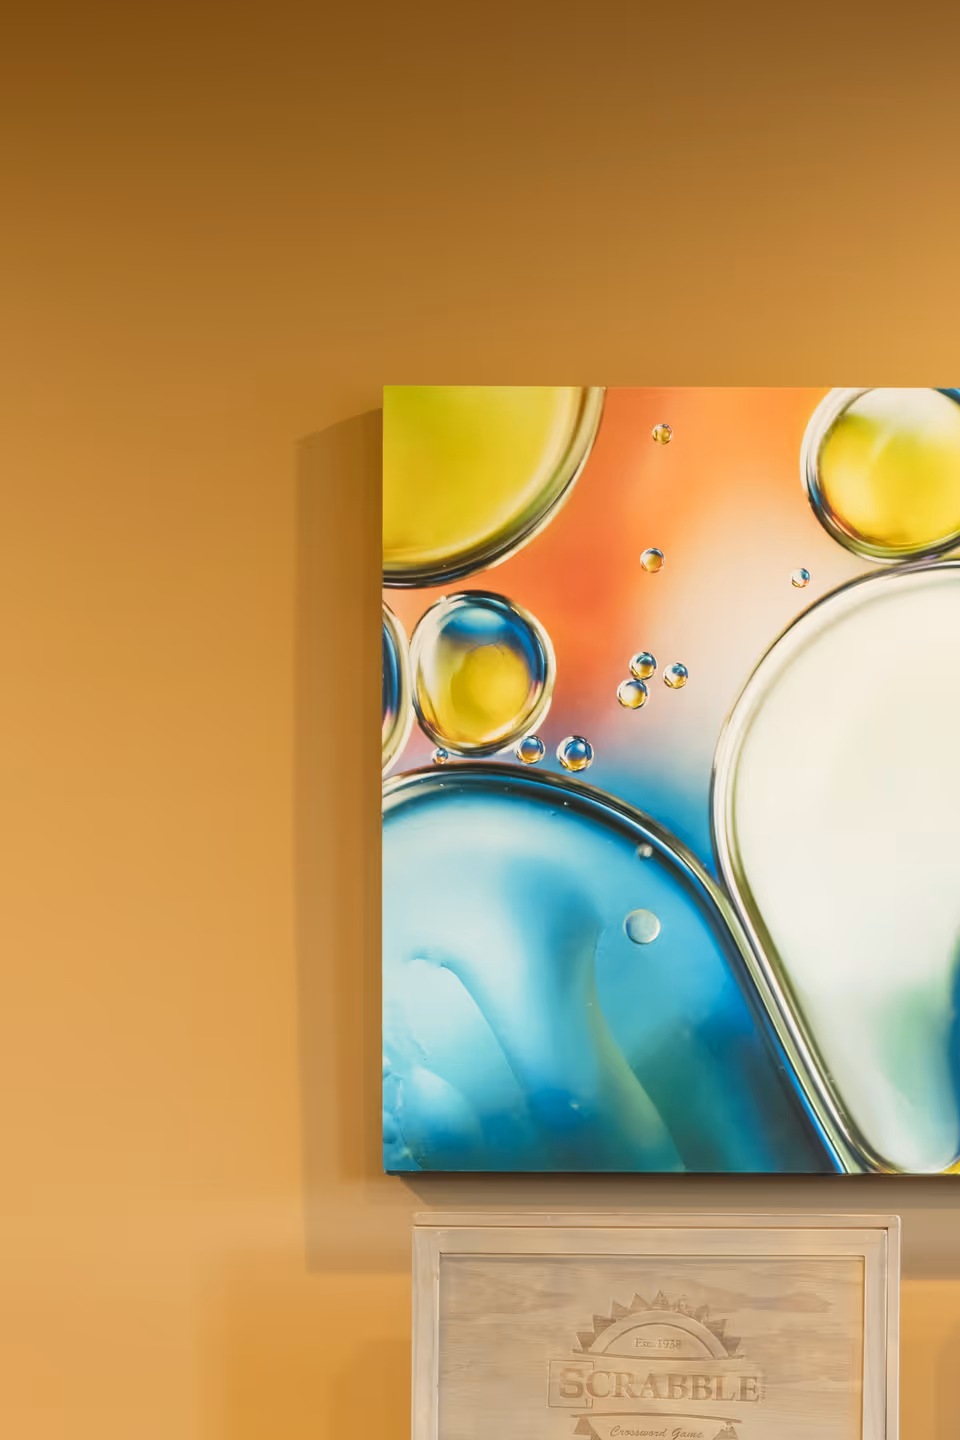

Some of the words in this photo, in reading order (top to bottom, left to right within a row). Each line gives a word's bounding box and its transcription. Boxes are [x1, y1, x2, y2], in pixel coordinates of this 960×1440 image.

[559, 1367, 760, 1402] SCRABBLE
[609, 1425, 668, 1438] Crossword
[672, 1427, 703, 1440] Game
